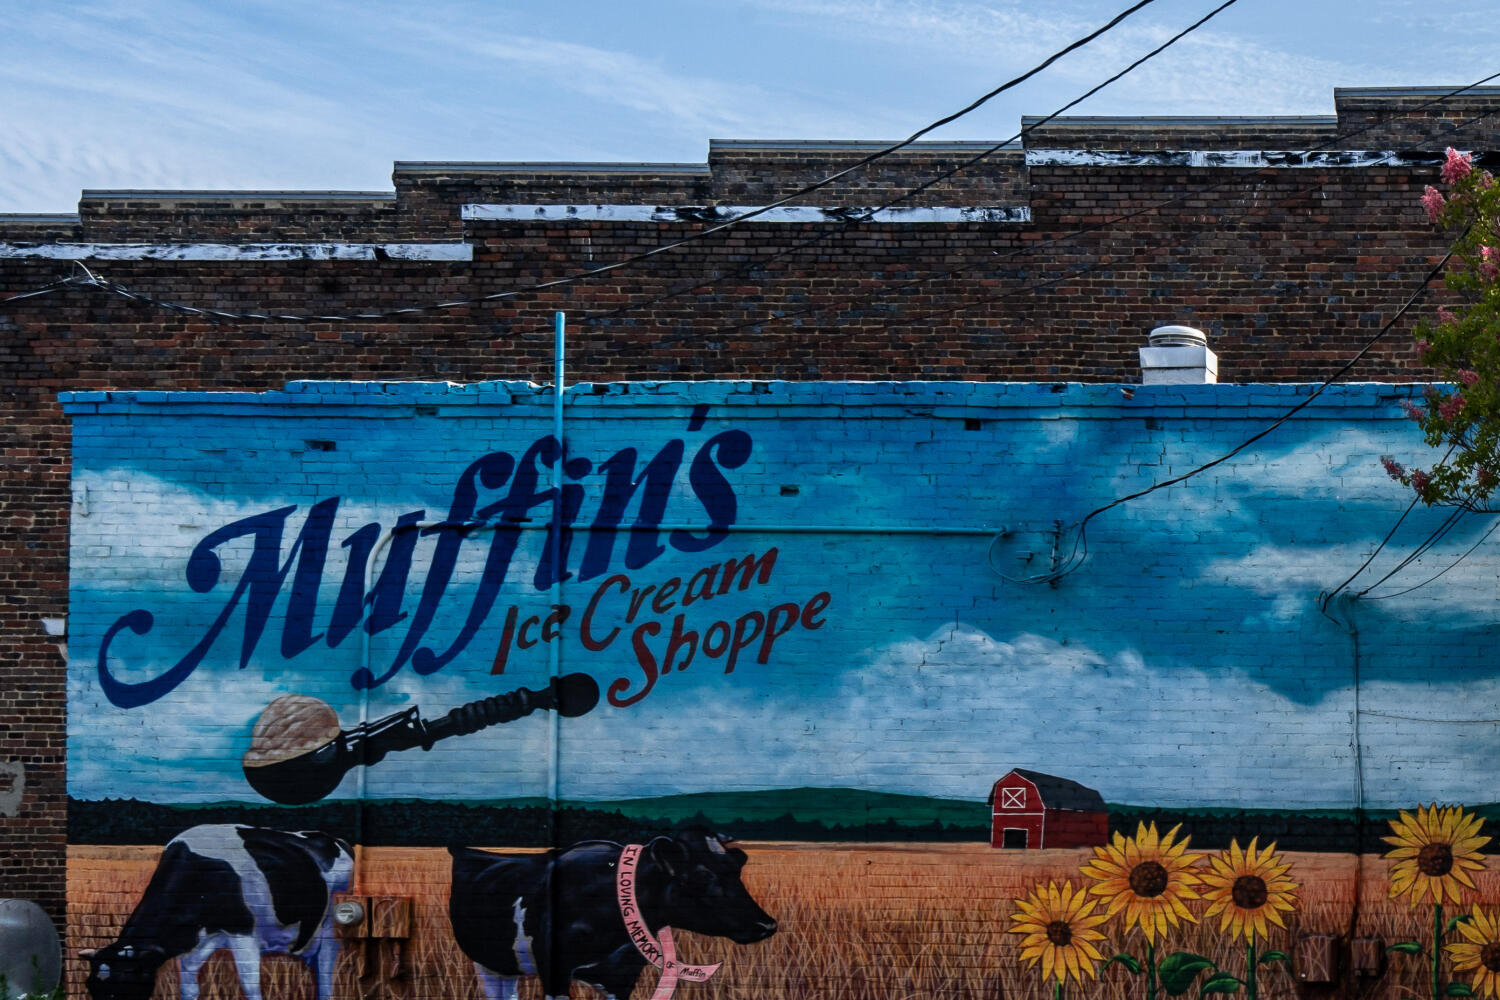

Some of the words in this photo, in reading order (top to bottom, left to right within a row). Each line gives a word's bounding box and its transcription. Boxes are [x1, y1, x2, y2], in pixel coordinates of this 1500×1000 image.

[98, 404, 752, 709] Muffin's
[490, 605, 571, 676] Ice
[580, 546, 779, 651] Cream
[606, 591, 832, 708] Shoppe
[622, 847, 638, 866] IN
[620, 871, 635, 917] LOVING
[627, 920, 662, 963] MEMORY
[680, 967, 706, 977] Muffin
